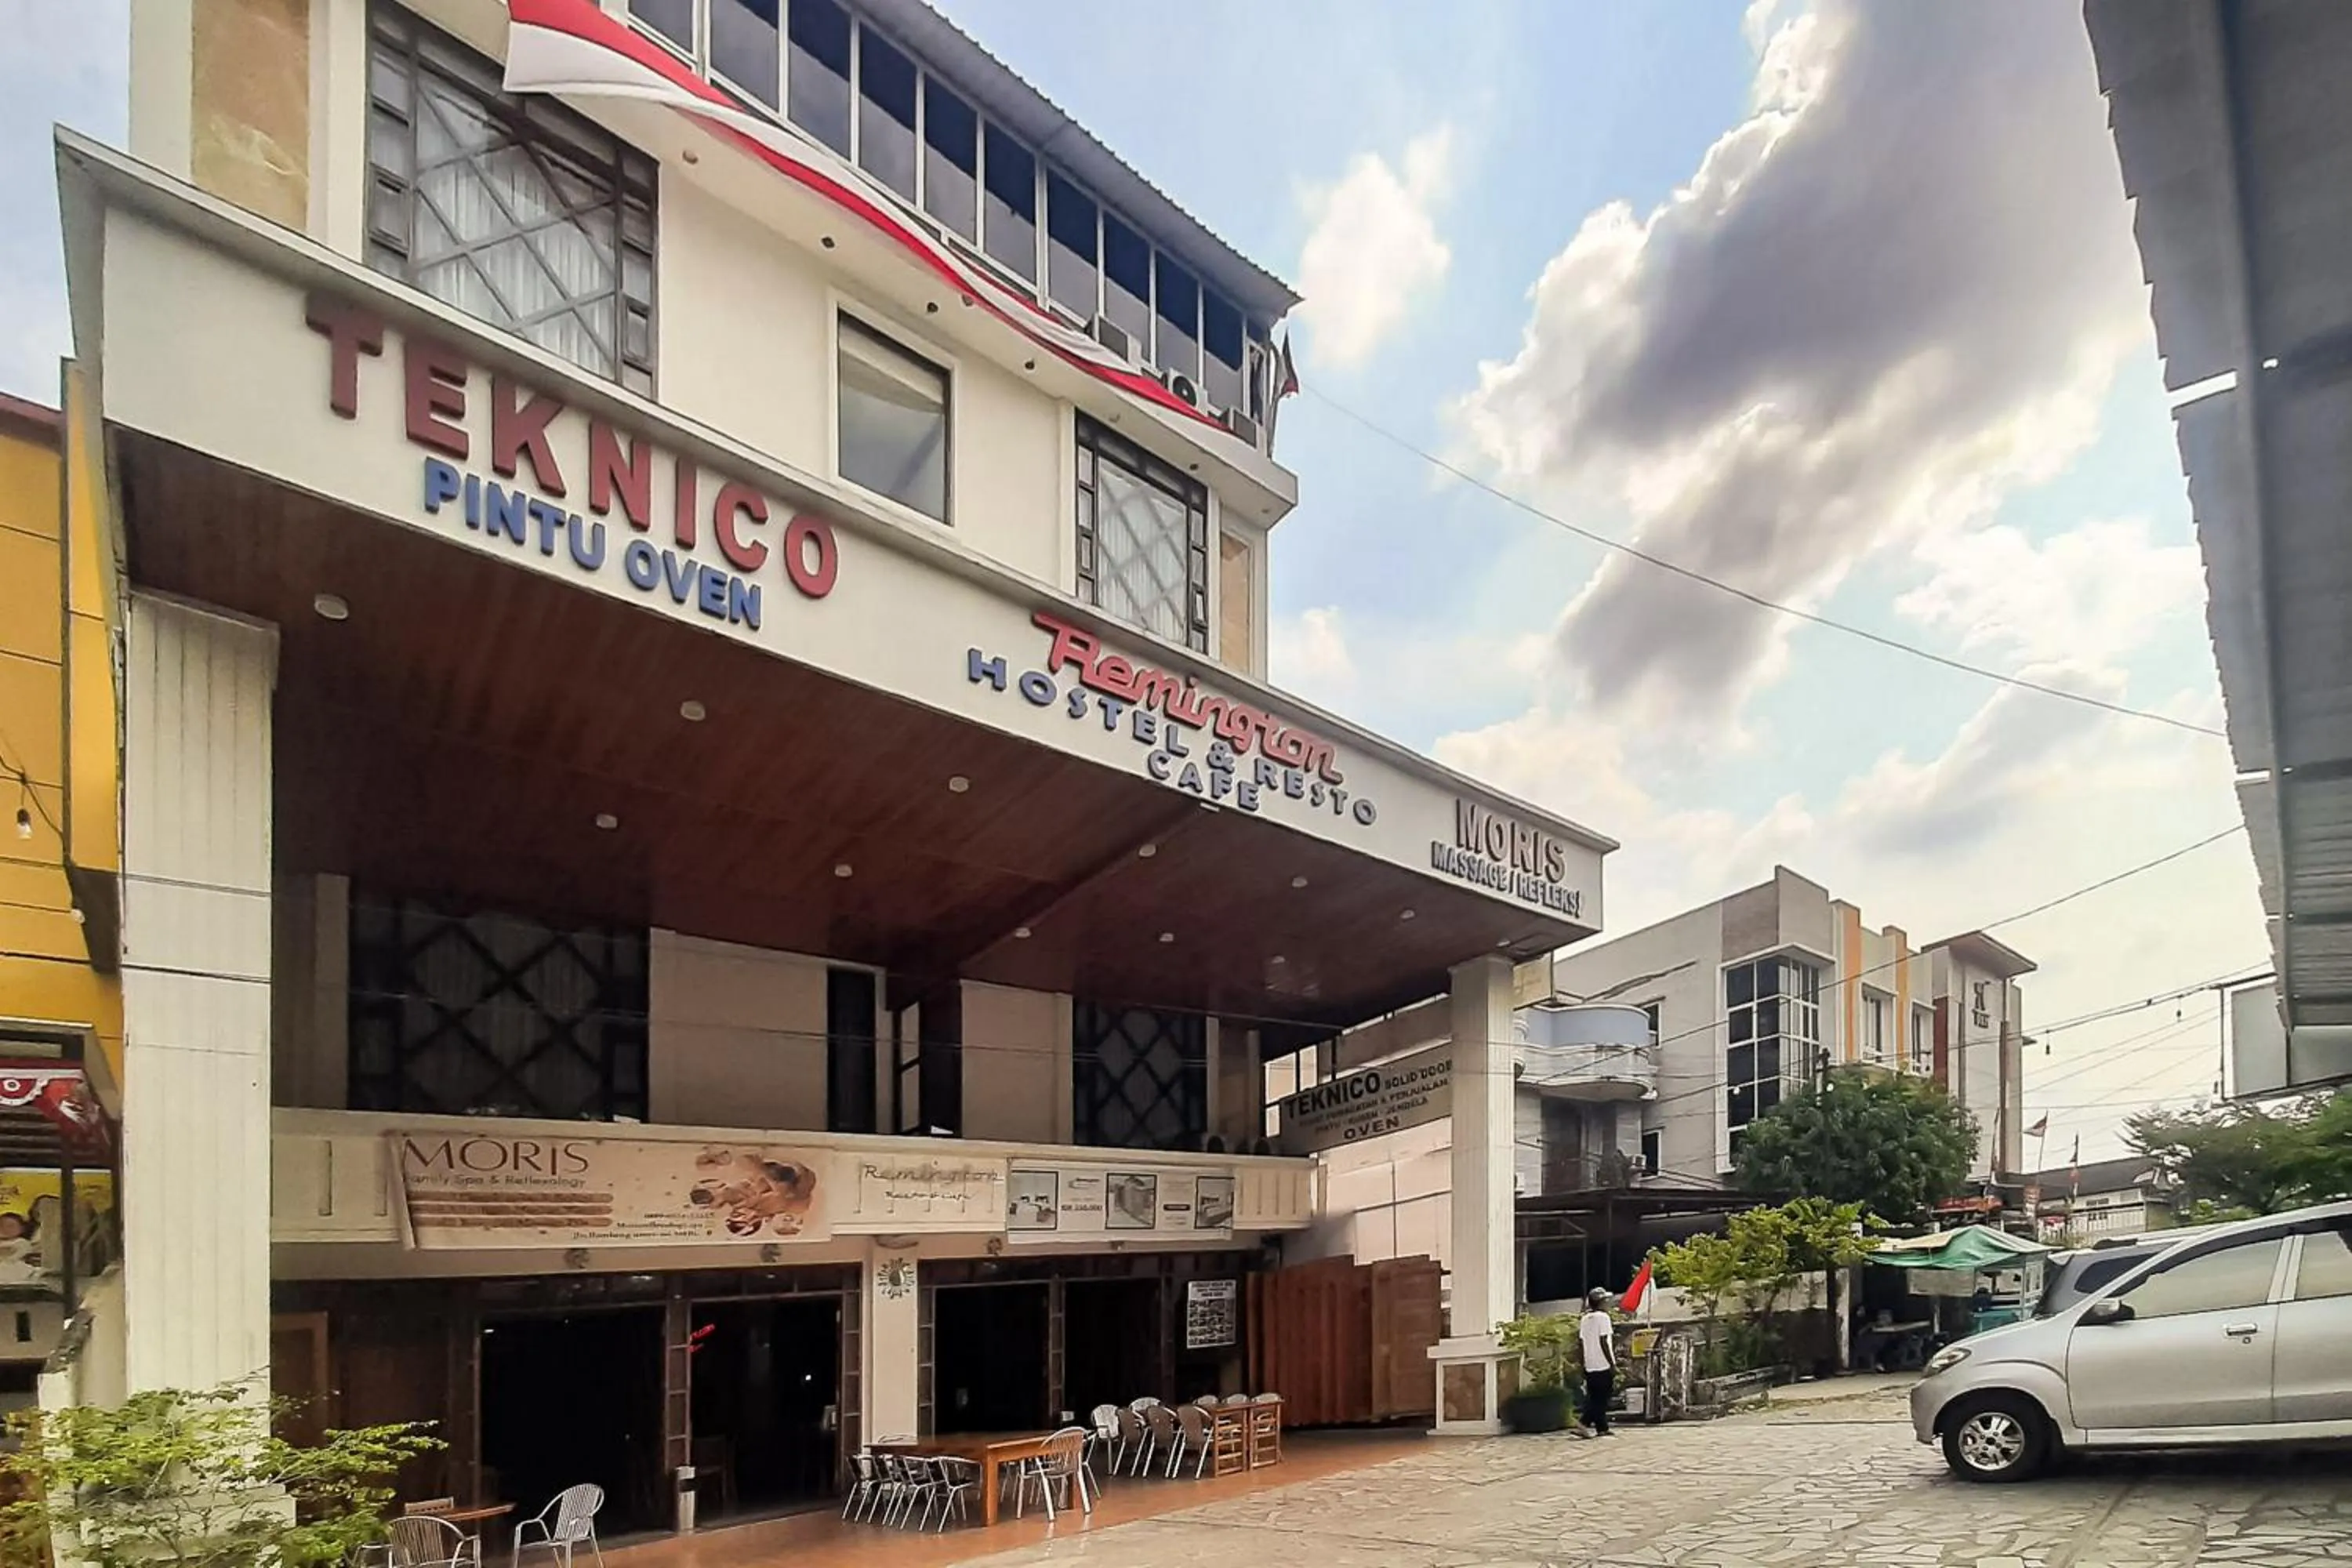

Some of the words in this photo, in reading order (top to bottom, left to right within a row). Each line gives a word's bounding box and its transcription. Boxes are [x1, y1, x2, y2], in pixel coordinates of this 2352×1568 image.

[306, 293, 838, 598] TEKNICO
[424, 456, 606, 570] PINTU
[627, 539, 761, 630] OVEN
[967, 648, 1189, 757] HOSTEL
[1207, 741, 1236, 772] &
[1255, 757, 1377, 826] RESTO
[1031, 612, 1344, 785] Remington
[1148, 750, 1259, 811] CAFE
[1431, 840, 1507, 891] MASSAGE
[1517, 873, 1580, 919] REFLEKSI
[1456, 798, 1566, 884] MORIS
[1285, 1072, 1381, 1119] TEKNICO
[1385, 1072, 1417, 1090] SOLID
[1344, 1116, 1399, 1140] OVEN
[403, 1139, 589, 1176] MORIS
